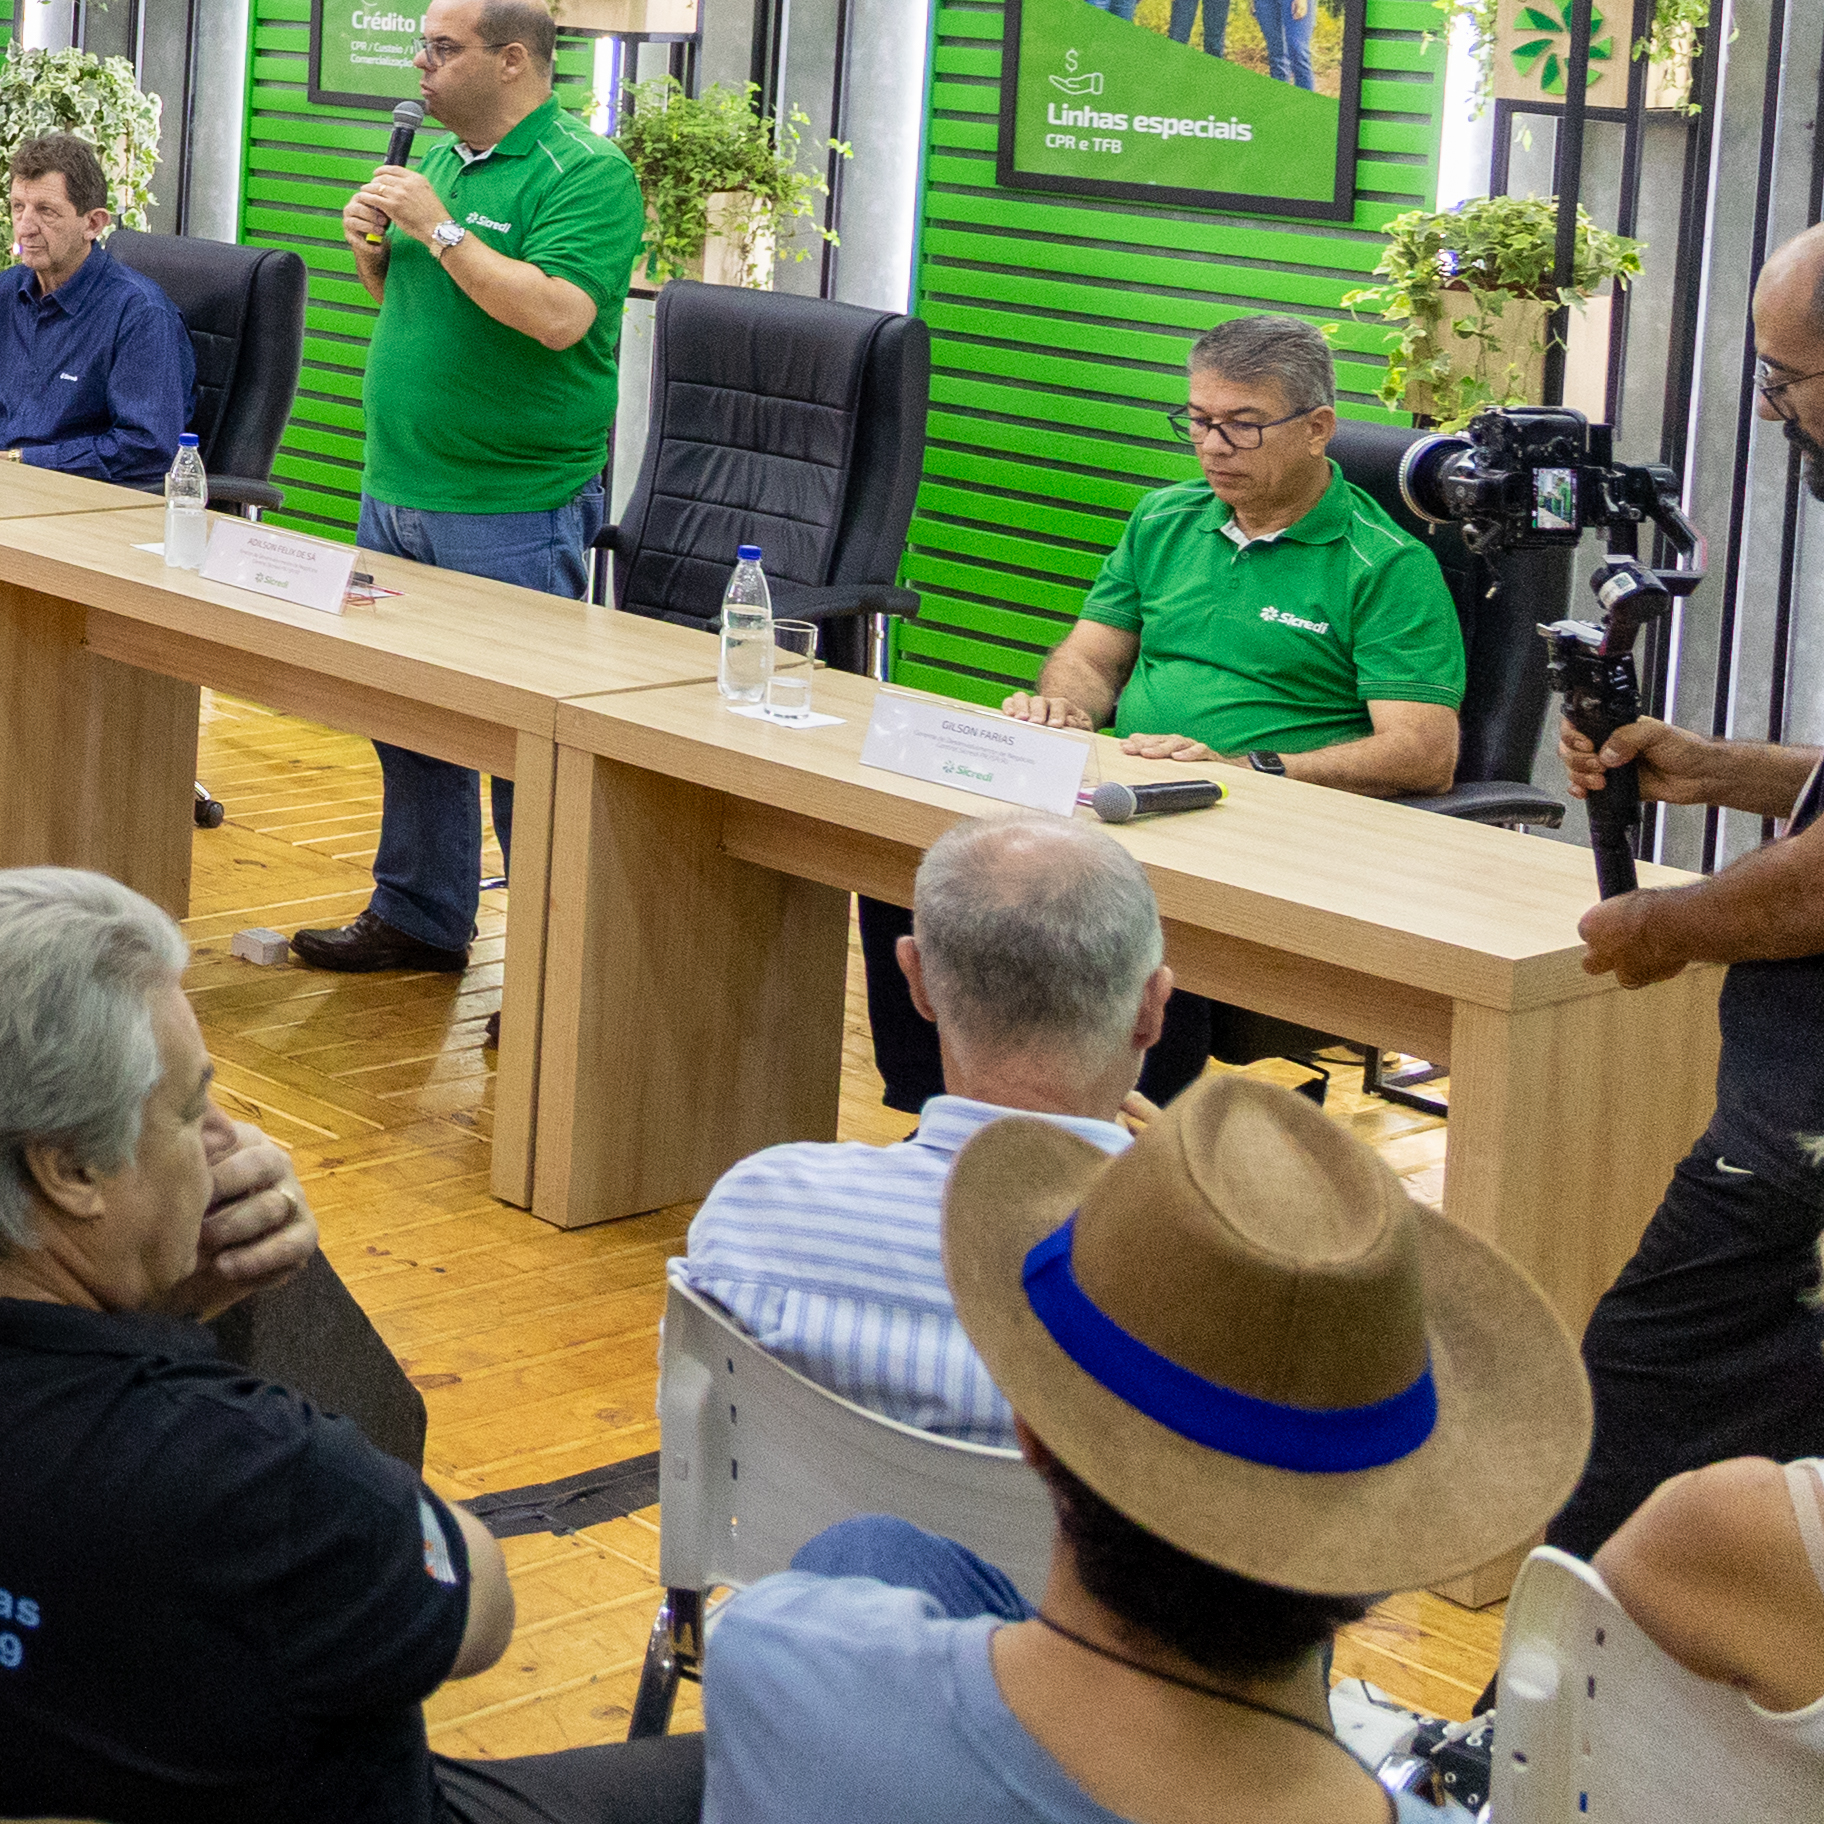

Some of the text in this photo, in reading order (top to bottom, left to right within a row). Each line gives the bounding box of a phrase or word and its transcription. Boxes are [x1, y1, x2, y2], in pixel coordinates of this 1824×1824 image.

[352, 10, 416, 33] Crédito
[1047, 102, 1252, 142] Linhas especiais
[1045, 134, 1122, 154] CPR e TFB
[476, 215, 512, 234] Sicredi
[247, 538, 277, 551] ADILSON
[277, 545, 295, 556] FELIX
[296, 550, 306, 558] DE
[264, 576, 289, 588] Sicredi
[1277, 612, 1330, 635] Sicredi
[942, 720, 1015, 747] GILSON FARIAS
[955, 764, 993, 783] Sicredi
